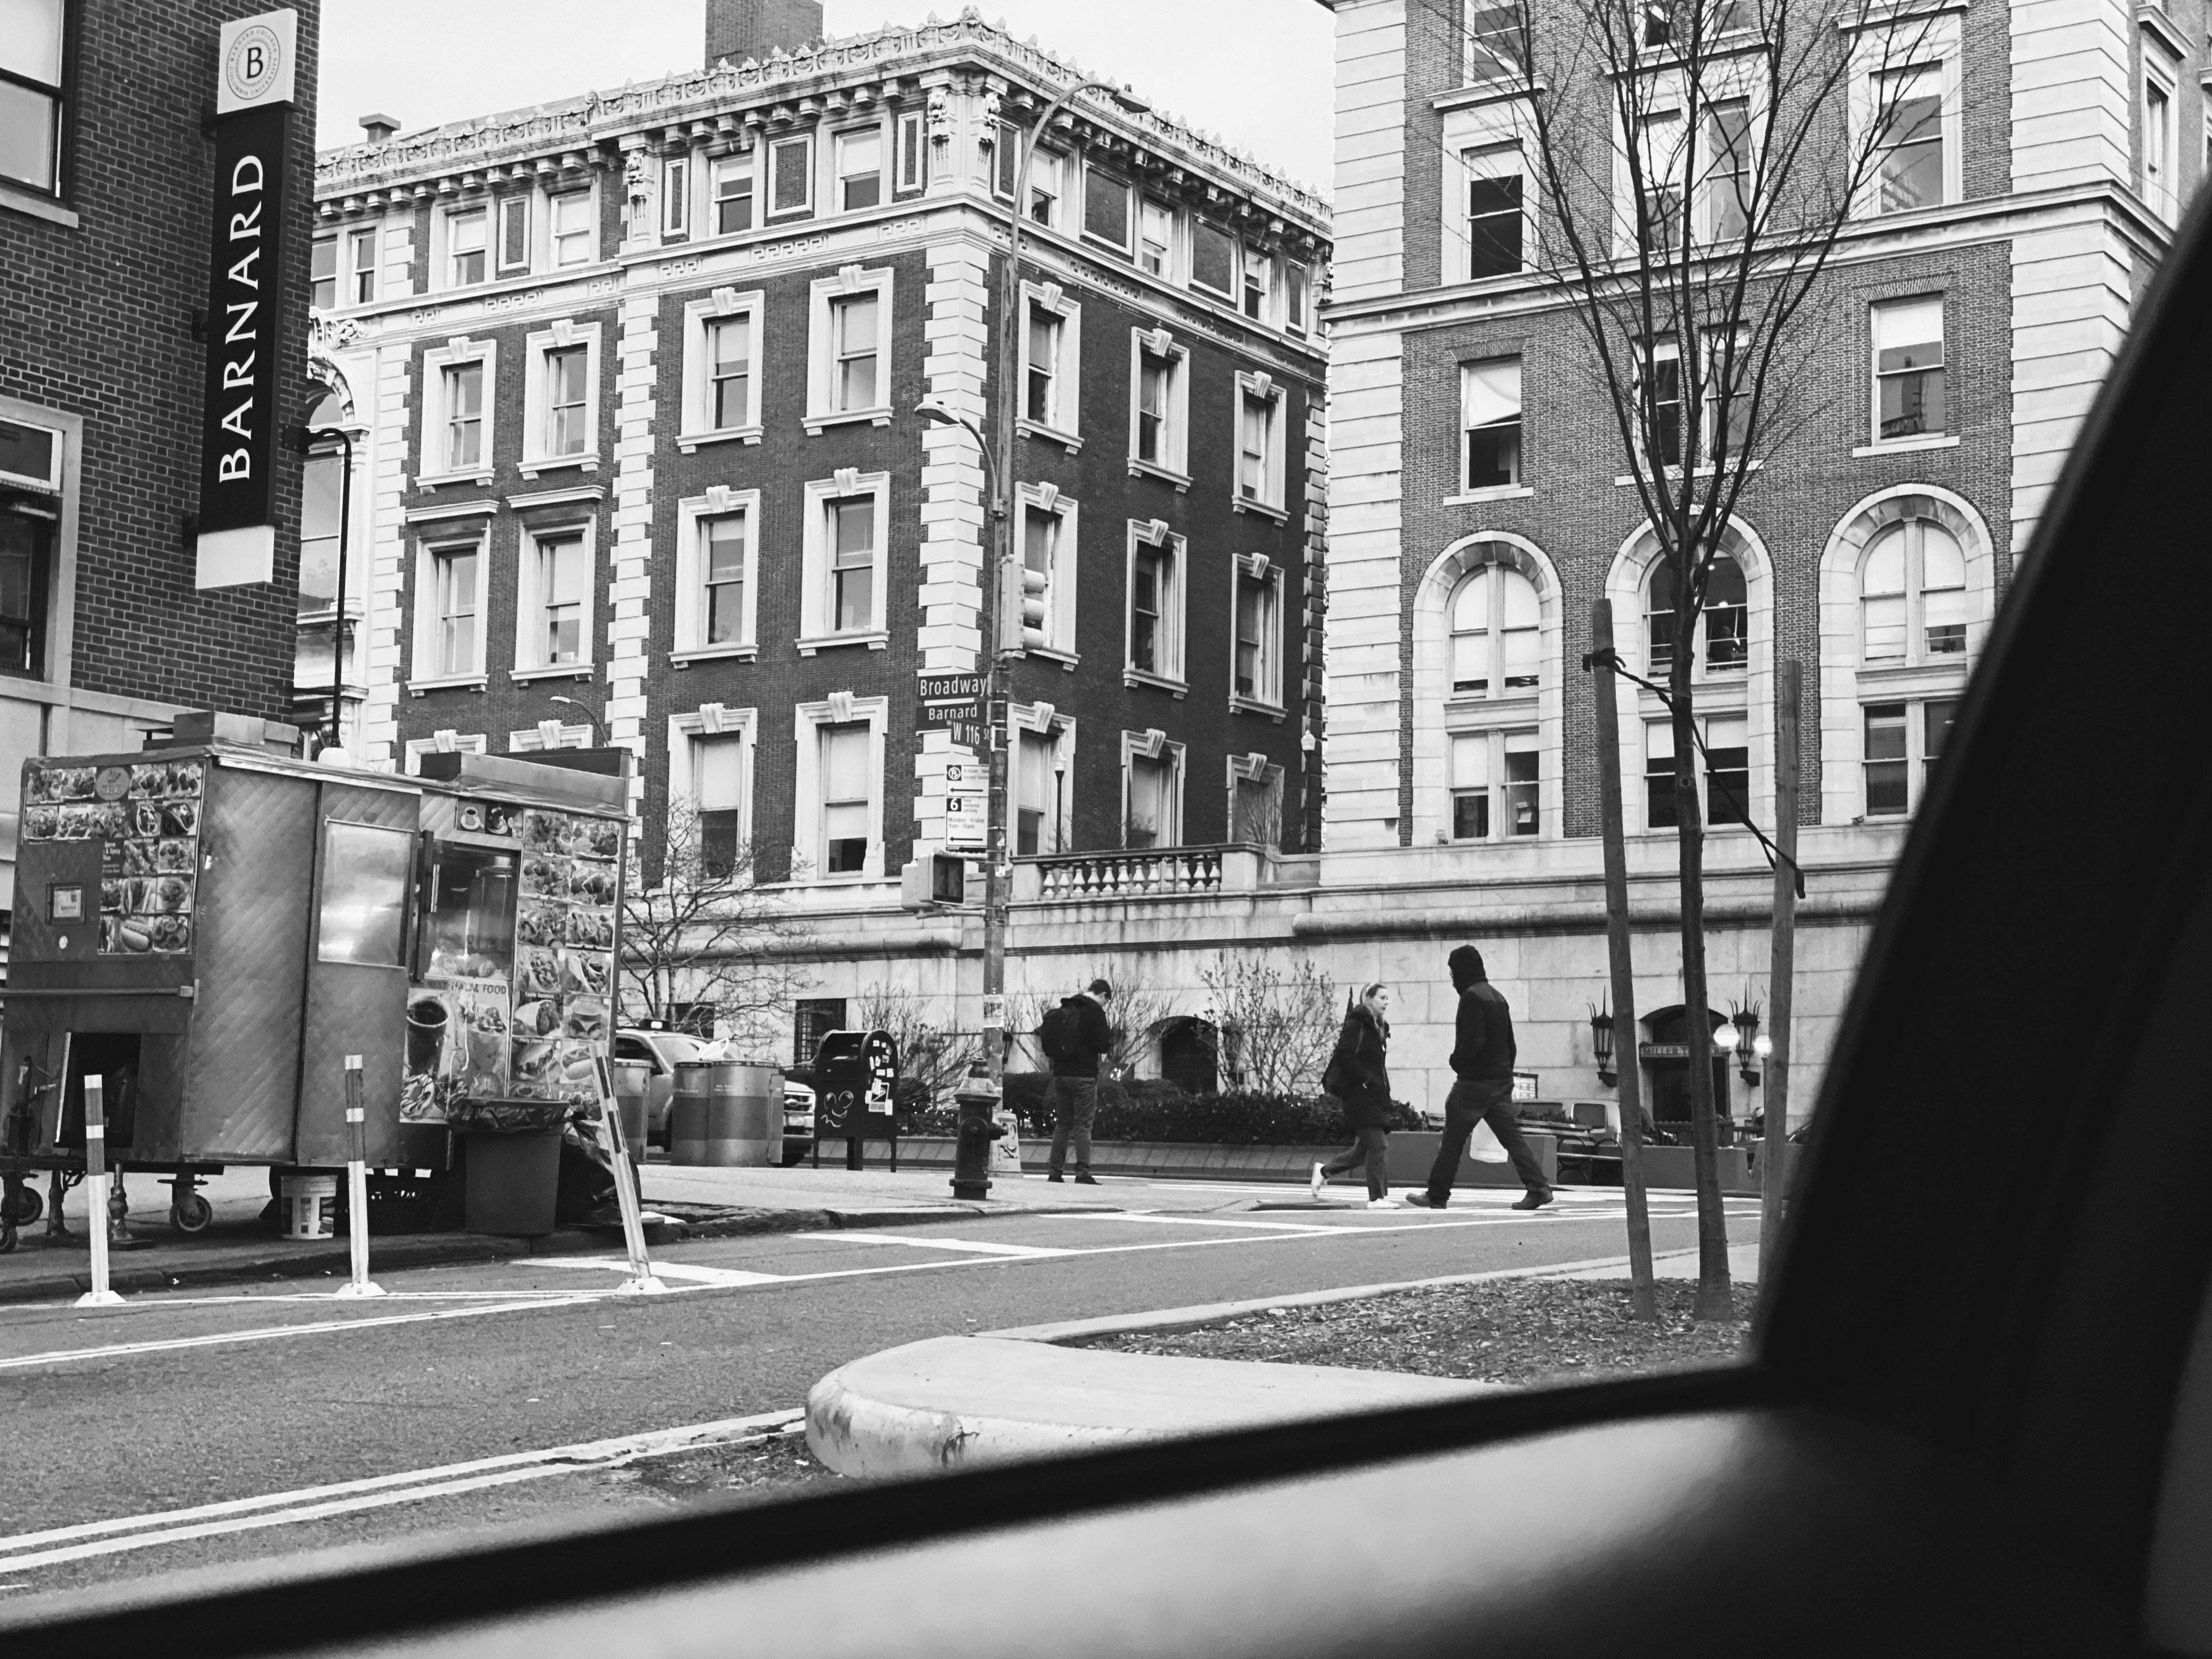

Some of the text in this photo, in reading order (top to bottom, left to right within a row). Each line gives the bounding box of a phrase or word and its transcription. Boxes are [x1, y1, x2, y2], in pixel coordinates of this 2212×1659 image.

[230, 29, 278, 62] BARNARD COLLEGE
[246, 47, 263, 79] B
[229, 57, 278, 96] COLUMBIA UNIVERSITY
[219, 155, 263, 483] BARNARD
[920, 675, 986, 697] Broadway
[928, 704, 977, 720] Barnard
[953, 721, 989, 745] W 116 St
[101, 785, 122, 795] HALAL
[950, 798, 959, 811] 6
[483, 984, 507, 995] FOOD
[1644, 1047, 1677, 1055] MILLER
